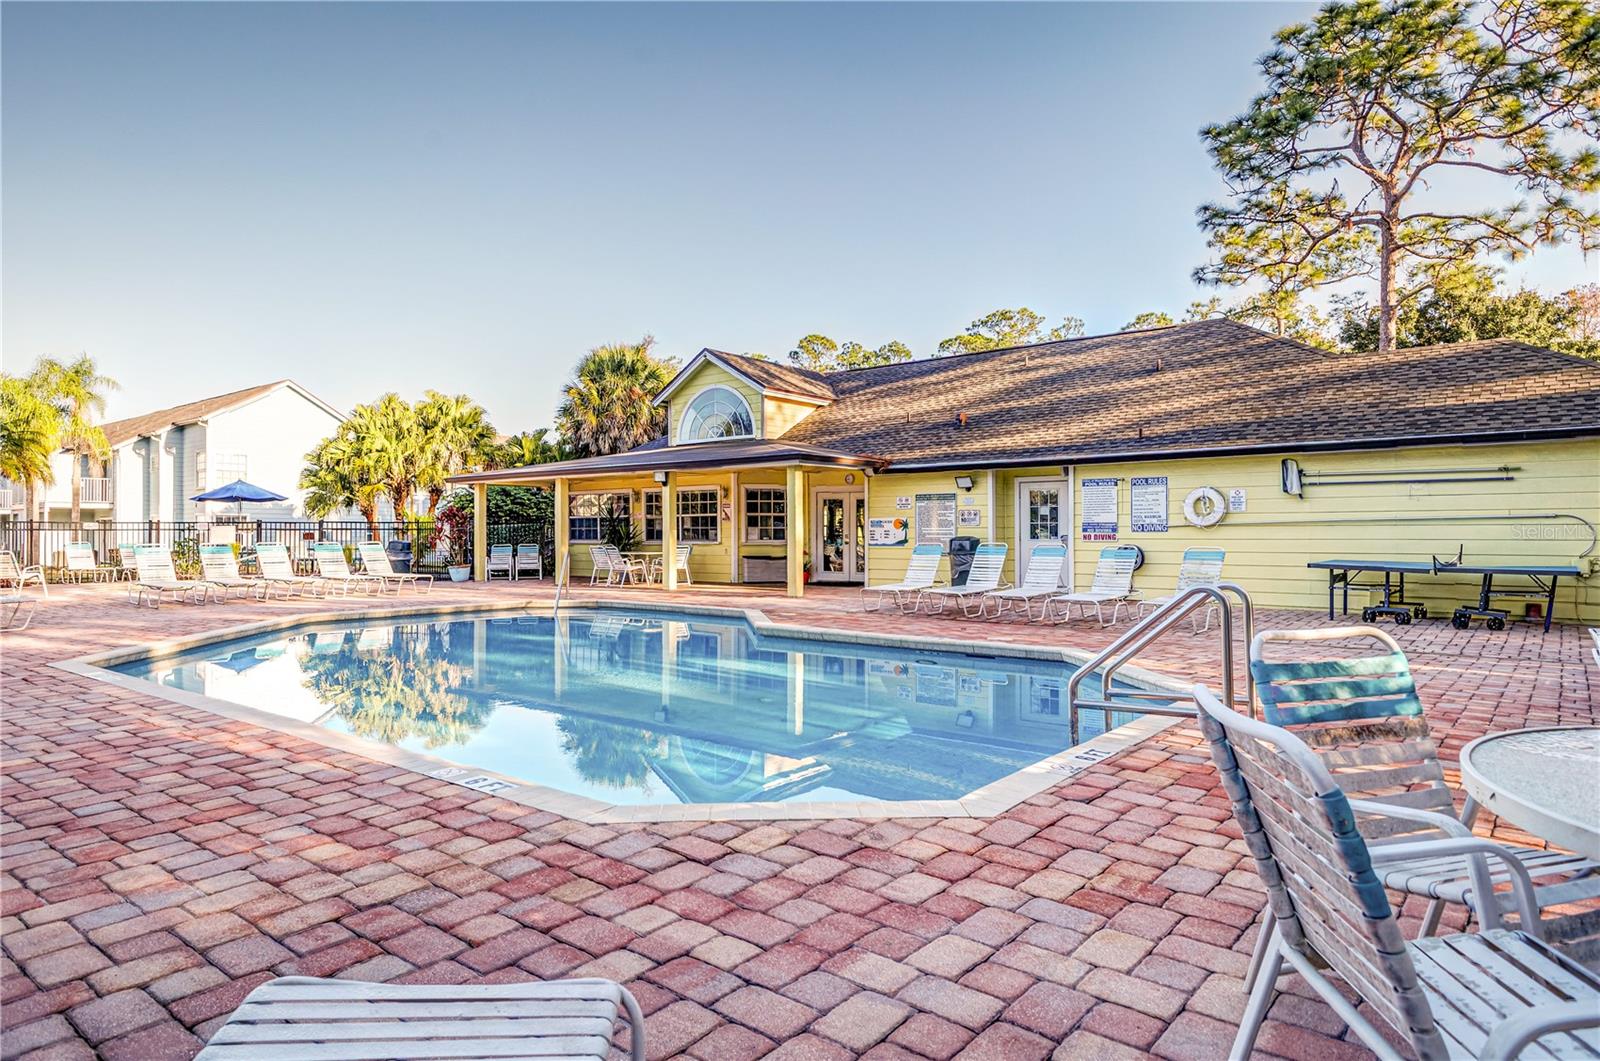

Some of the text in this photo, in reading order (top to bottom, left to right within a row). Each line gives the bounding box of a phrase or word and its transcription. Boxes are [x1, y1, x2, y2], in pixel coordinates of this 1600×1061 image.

[1083, 748, 1111, 757] FT
[464, 777, 515, 792] 6 FT
